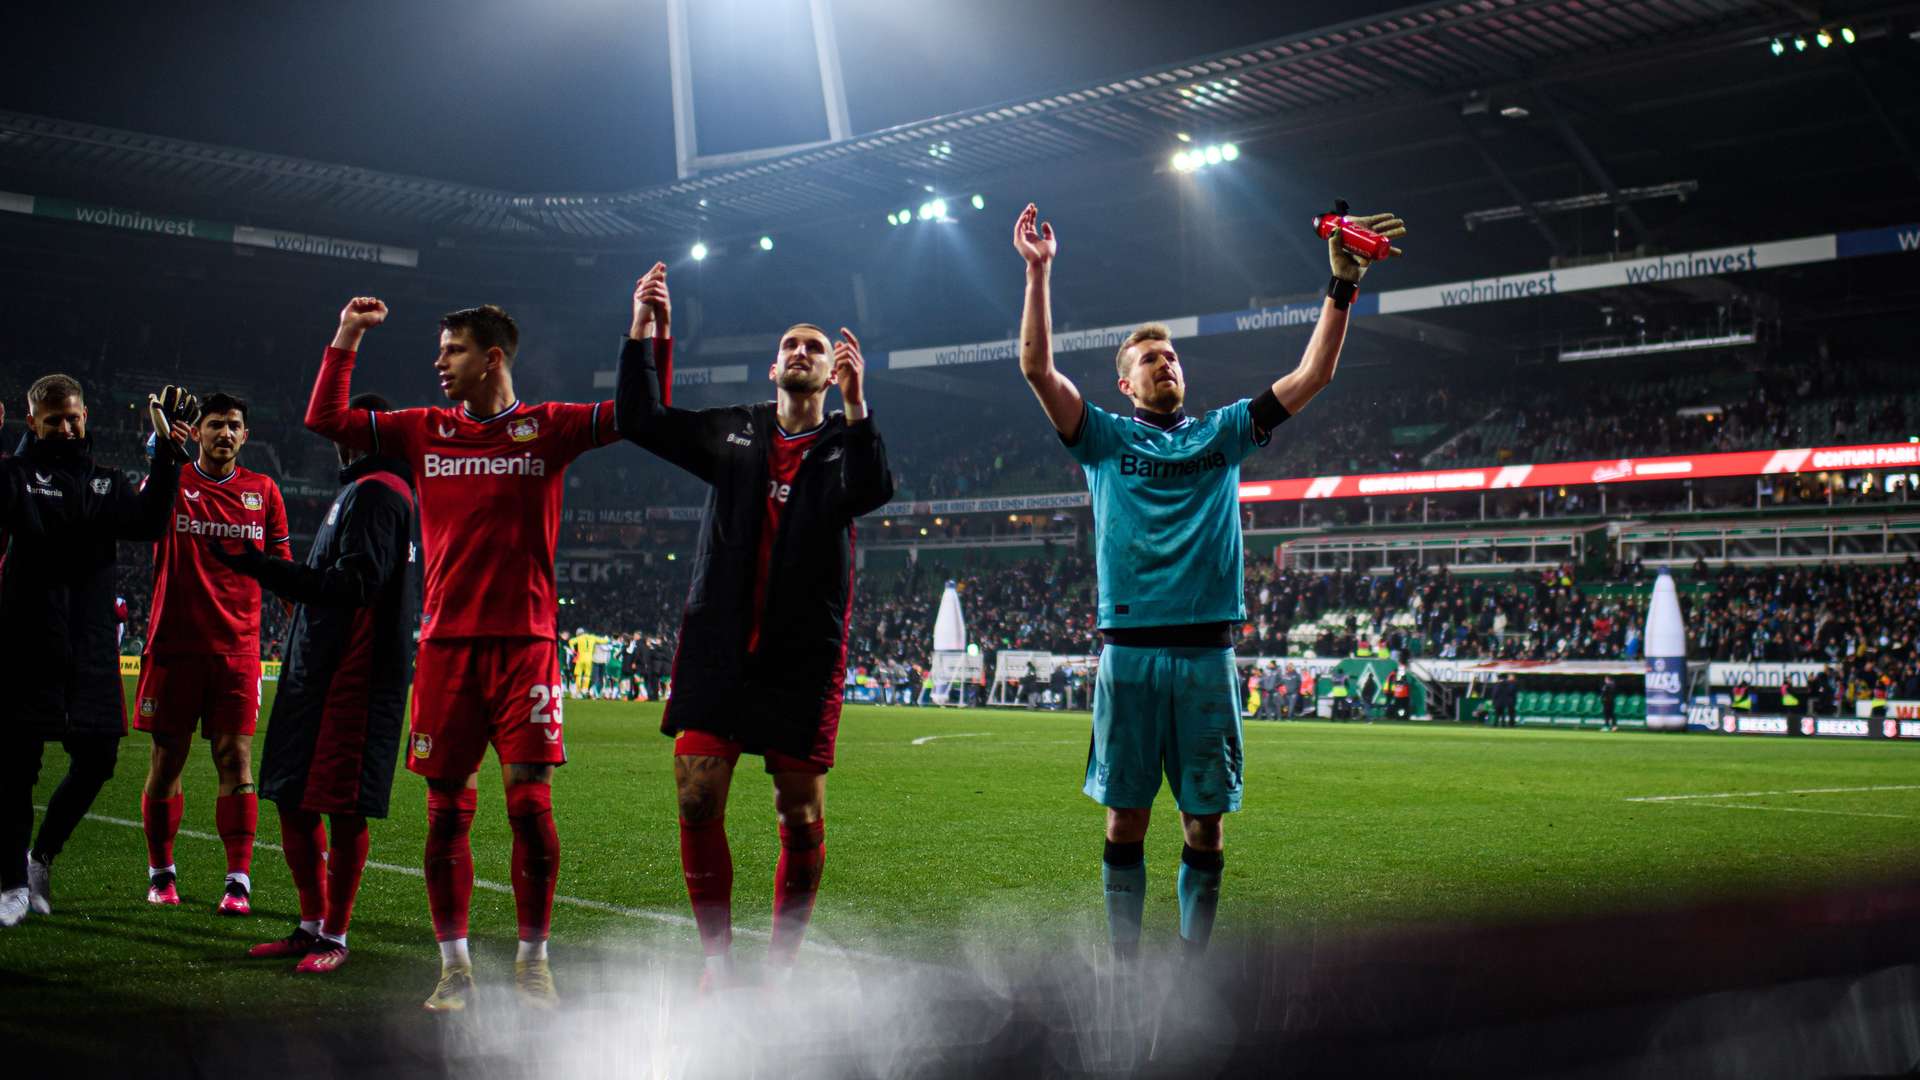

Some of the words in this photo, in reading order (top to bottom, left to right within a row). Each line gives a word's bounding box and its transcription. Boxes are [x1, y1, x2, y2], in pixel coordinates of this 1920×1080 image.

[77, 207, 195, 237] wohninvest
[274, 235, 384, 262] wohninvest
[1625, 247, 1757, 284] wohninvest
[1440, 274, 1556, 306] wohninvest
[1236, 305, 1320, 330] wohninve
[1062, 329, 1131, 351] wohninve
[934, 344, 1017, 366] wohninvest
[424, 452, 545, 478] Barmenia
[1120, 450, 1227, 478] Barmenia
[176, 514, 264, 540] Barmenia
[529, 684, 563, 724] 23
